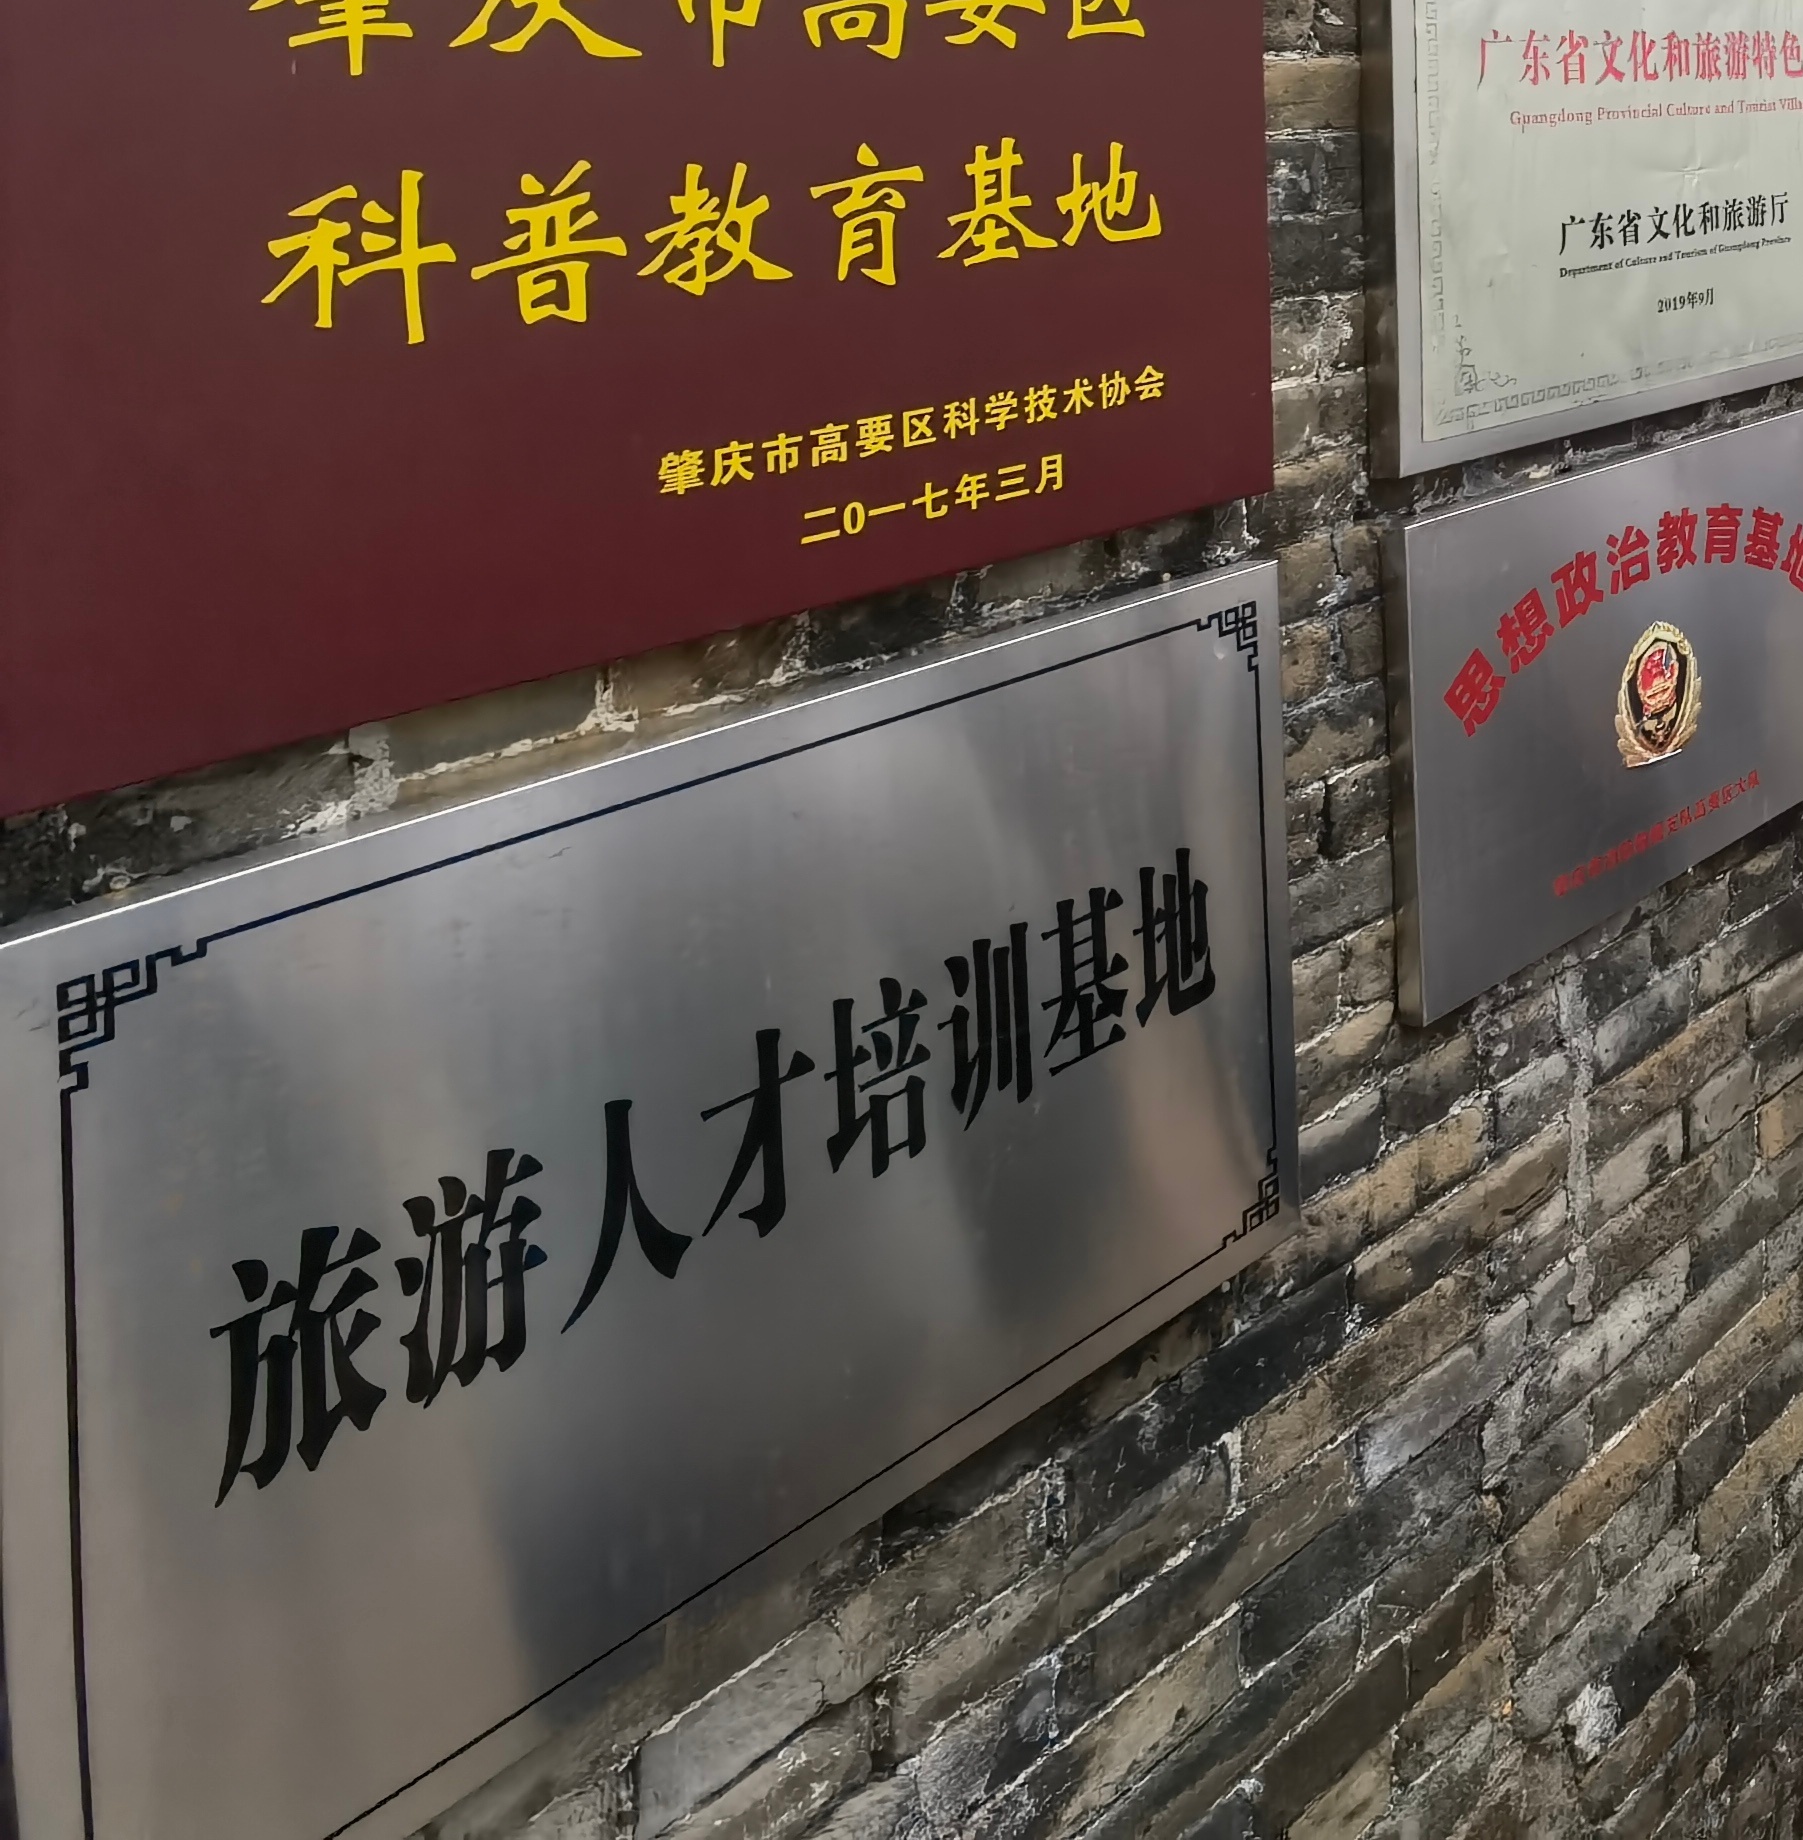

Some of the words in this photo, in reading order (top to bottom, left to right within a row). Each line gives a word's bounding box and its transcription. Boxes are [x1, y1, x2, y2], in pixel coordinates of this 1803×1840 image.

[1509, 109, 1593, 129] Guangdong
[1597, 103, 1663, 121] Provincial
[1666, 102, 1711, 117] Culture
[1714, 100, 1734, 115] and
[261, 136, 1163, 345] 科普教育基地
[1558, 189, 1790, 256] 广东省文化和旅游厅
[1657, 287, 1714, 314] 2019年9月
[657, 365, 1166, 497] 肇庆市高要区科学技术协会
[209, 847, 1217, 1510] 旅游人才培训基地
